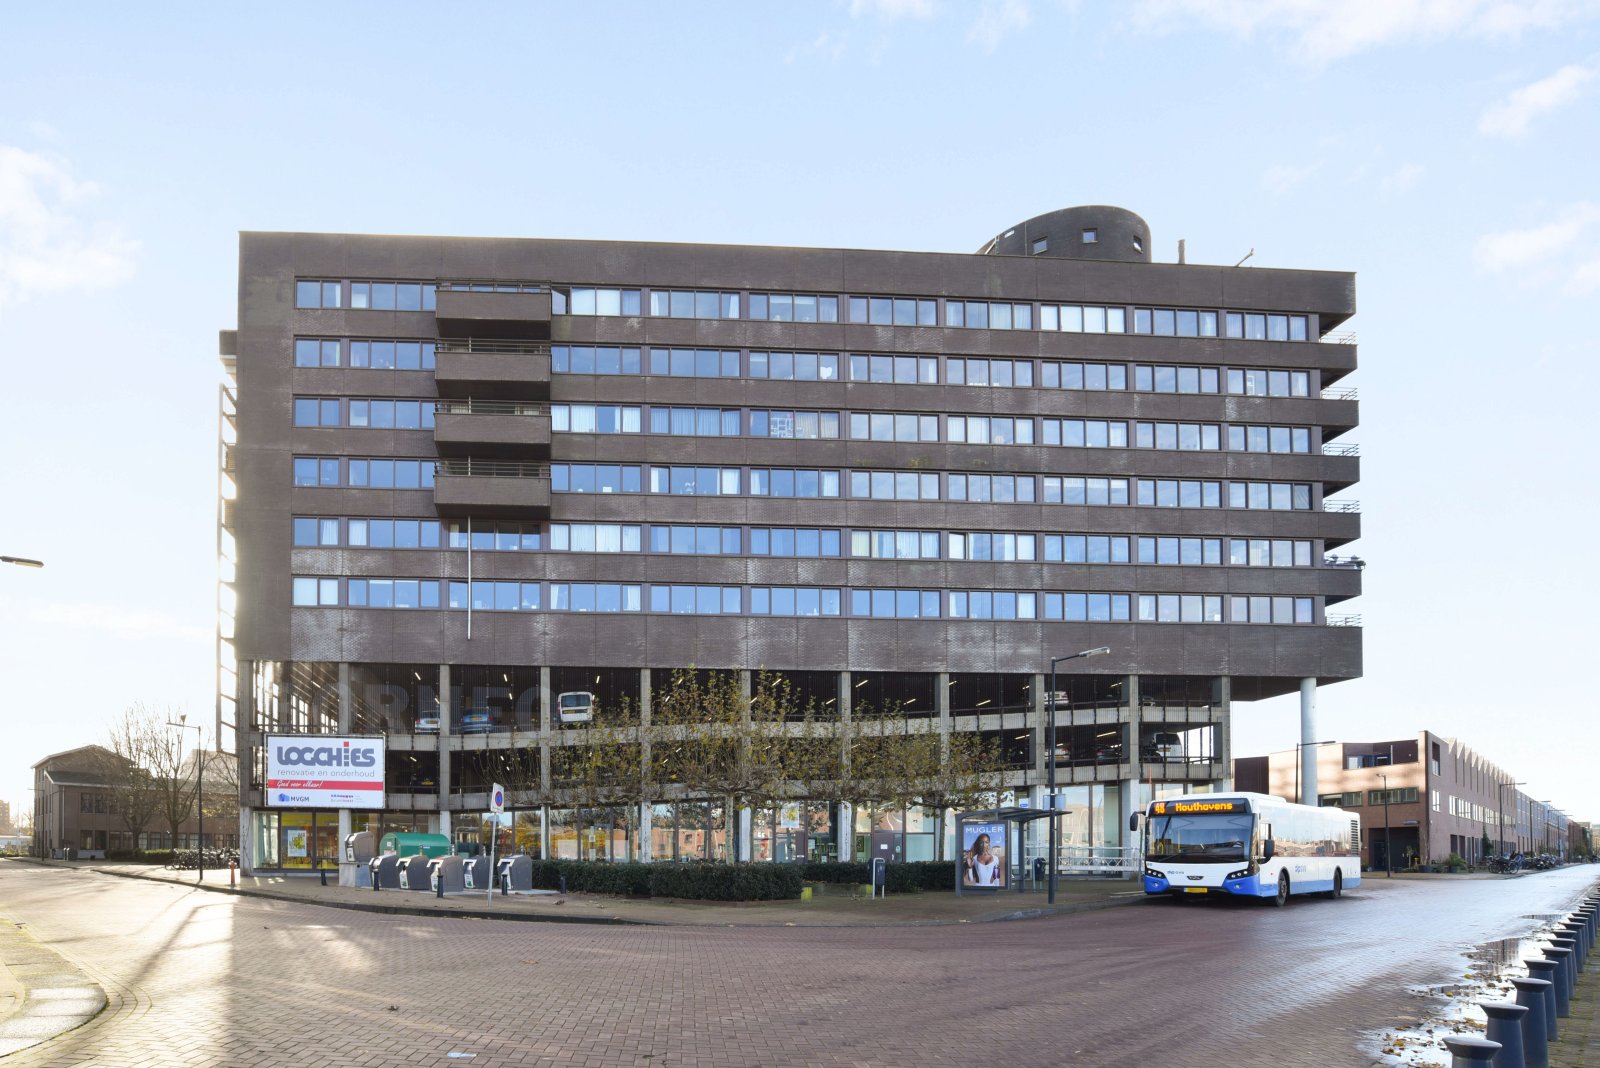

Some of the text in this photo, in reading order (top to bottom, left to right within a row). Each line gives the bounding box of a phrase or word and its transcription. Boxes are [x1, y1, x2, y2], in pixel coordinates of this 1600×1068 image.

[331, 769, 375, 777] onderhoud
[1175, 802, 1233, 812] Houthavens
[965, 826, 1004, 834] MUGLER
